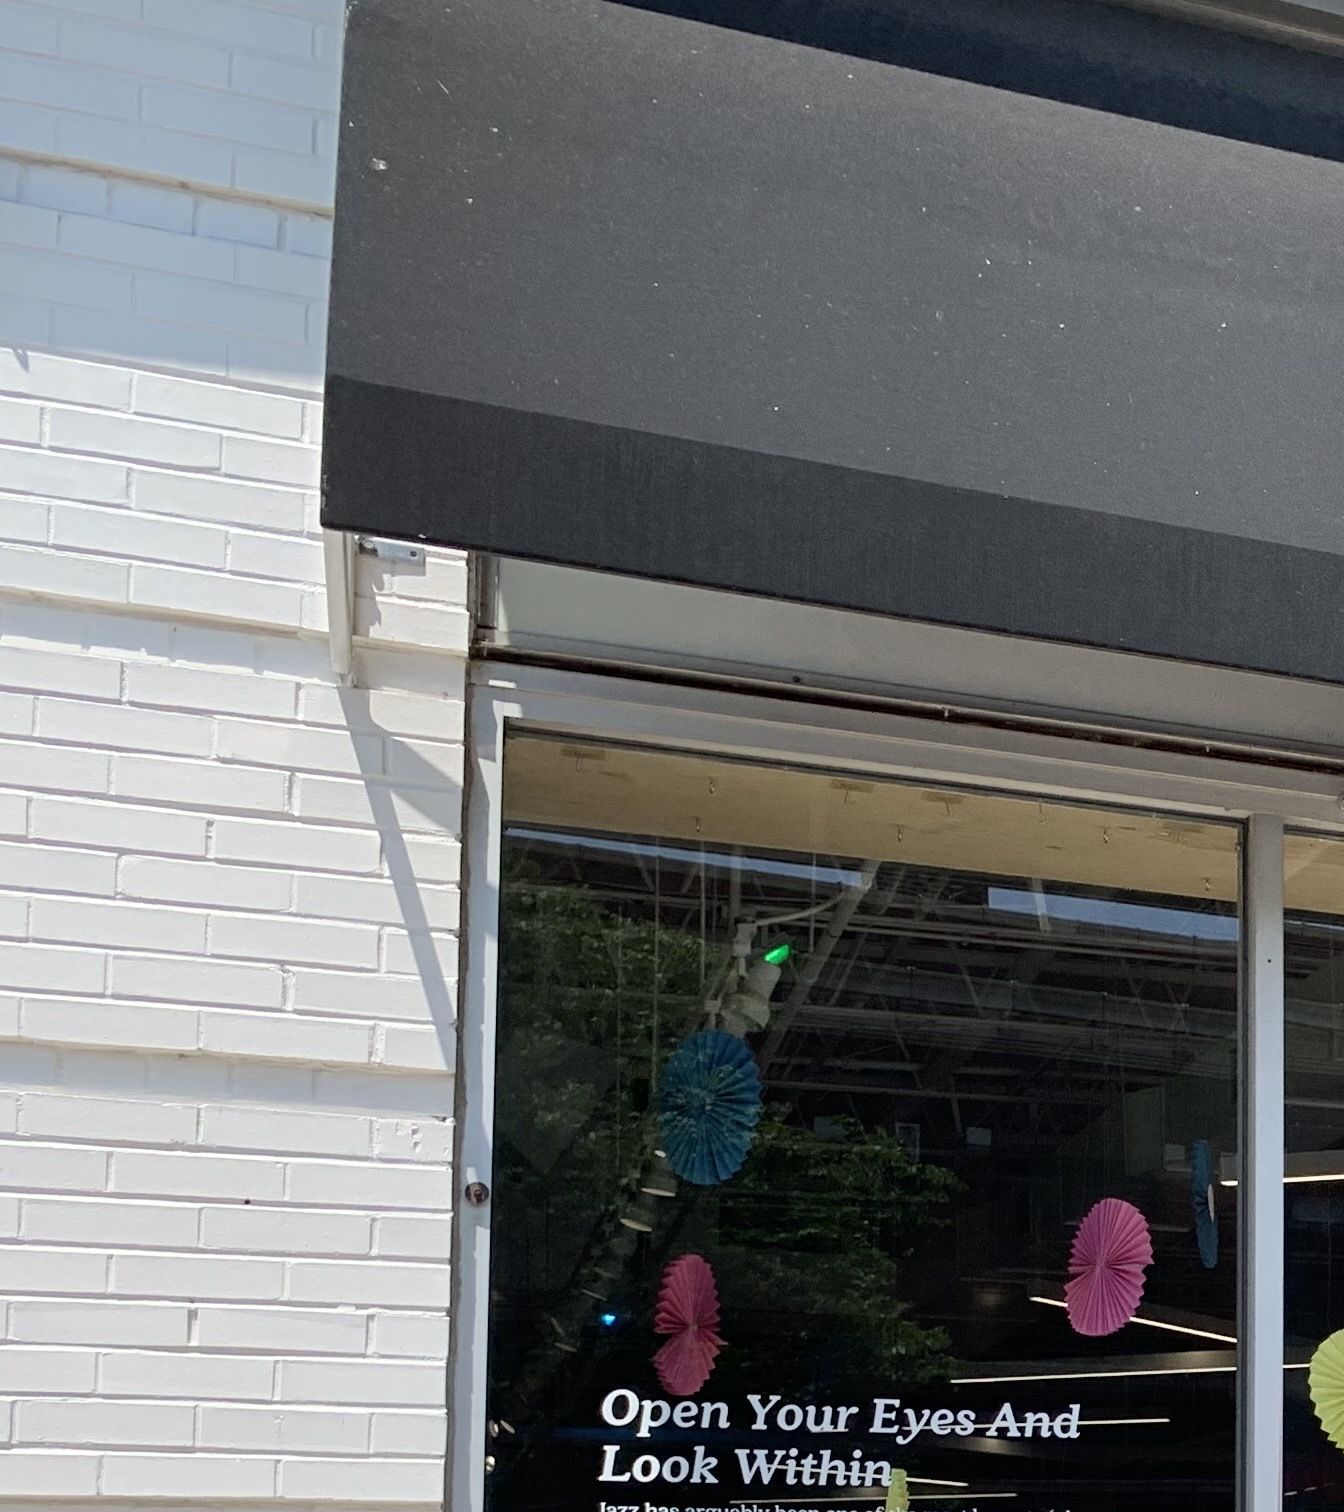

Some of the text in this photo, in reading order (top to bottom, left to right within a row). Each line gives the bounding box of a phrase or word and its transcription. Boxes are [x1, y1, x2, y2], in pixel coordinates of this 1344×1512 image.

[601, 1389, 1081, 1444] Open Your Eyes And
[598, 1444, 892, 1486] Look Within
